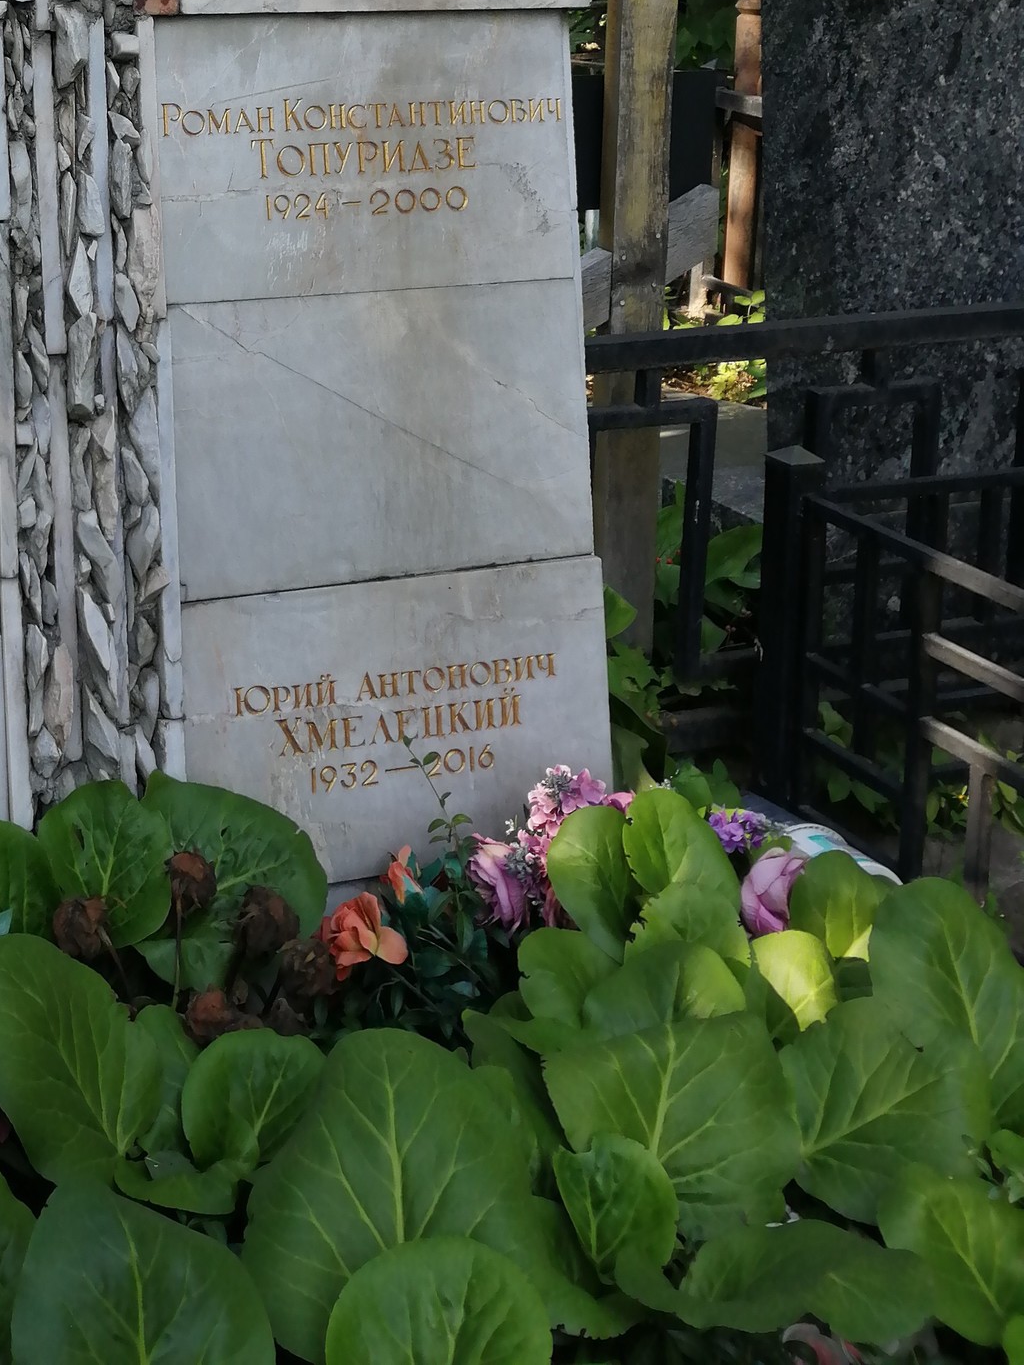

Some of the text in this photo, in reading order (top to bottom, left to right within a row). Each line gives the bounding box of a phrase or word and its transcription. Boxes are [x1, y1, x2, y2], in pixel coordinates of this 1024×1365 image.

[161, 98, 563, 138] РОМАН КОНСТАНТИНОВИЧ
[250, 136, 477, 180] ТОПУРИДЗЕ
[234, 653, 556, 718] ЮРИЙ АНТОНОВИЧ
[275, 687, 523, 757] ХМЕЛЕЦКИЙ
